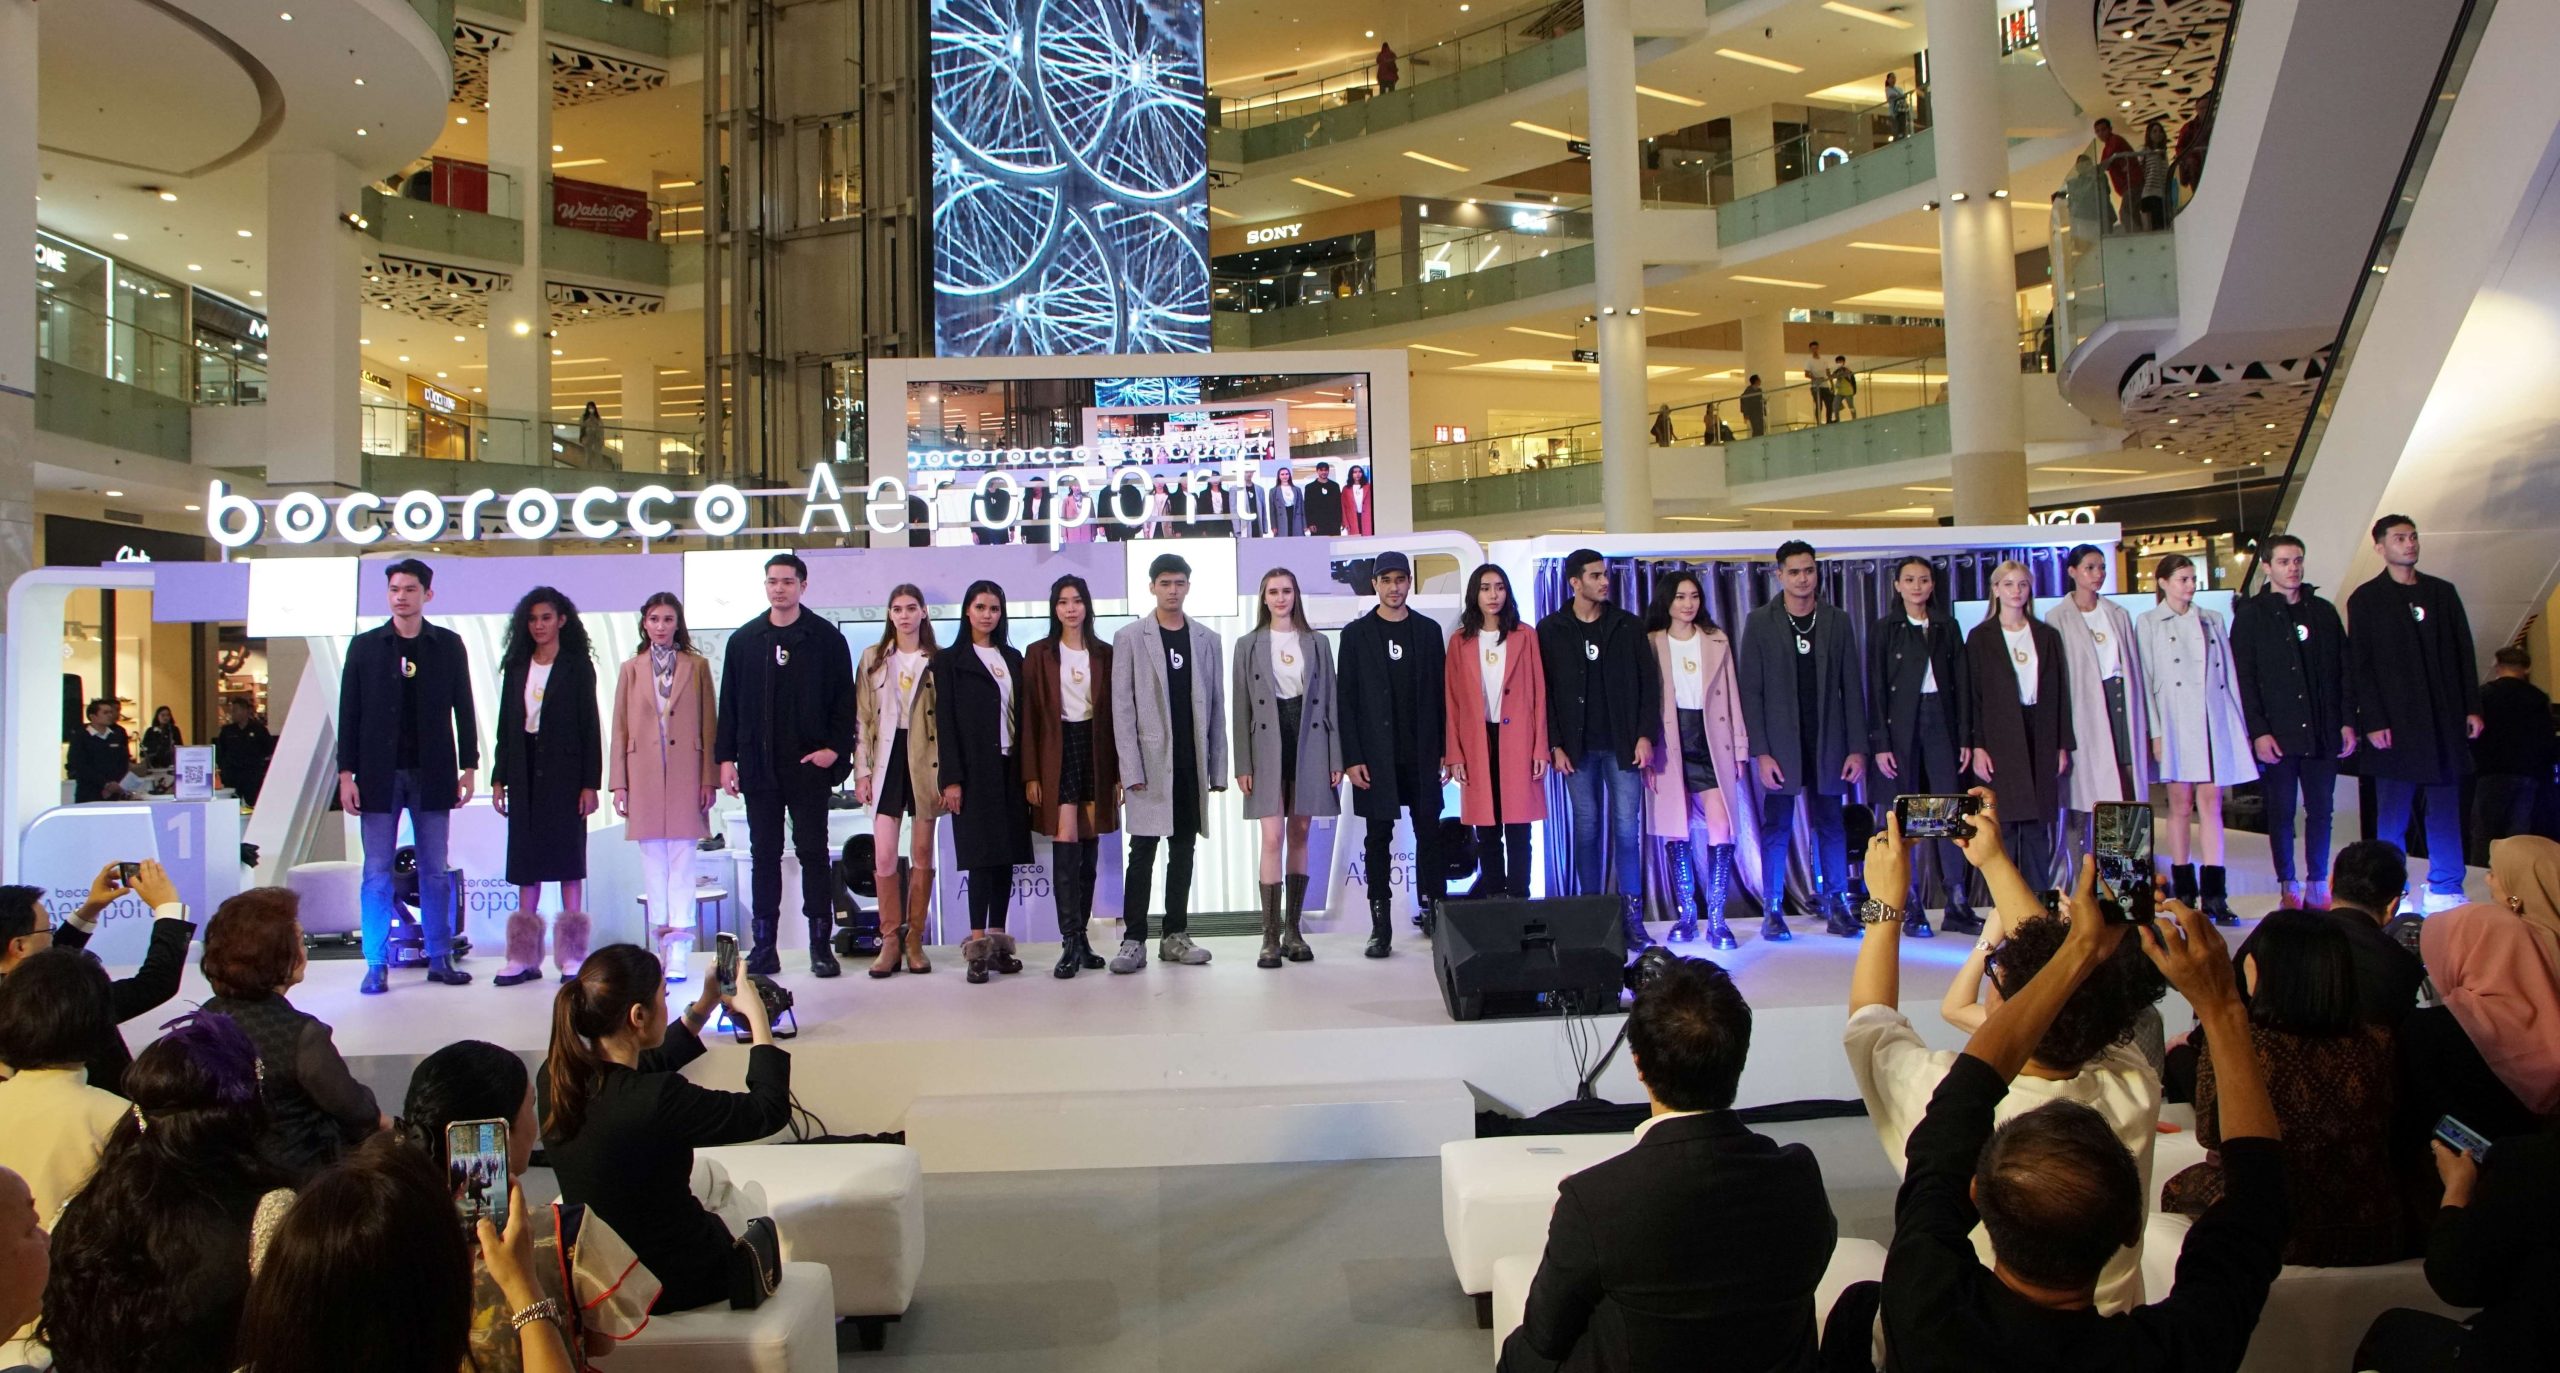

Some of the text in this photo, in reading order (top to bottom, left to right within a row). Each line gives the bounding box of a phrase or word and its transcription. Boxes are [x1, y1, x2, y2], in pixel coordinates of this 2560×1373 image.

[558, 201, 638, 220] WakaiGo
[1246, 223, 1302, 245] SONY
[208, 456, 1258, 551] bocorocco Aeroport
[167, 812, 191, 859] 1
[463, 879, 513, 888] orocco
